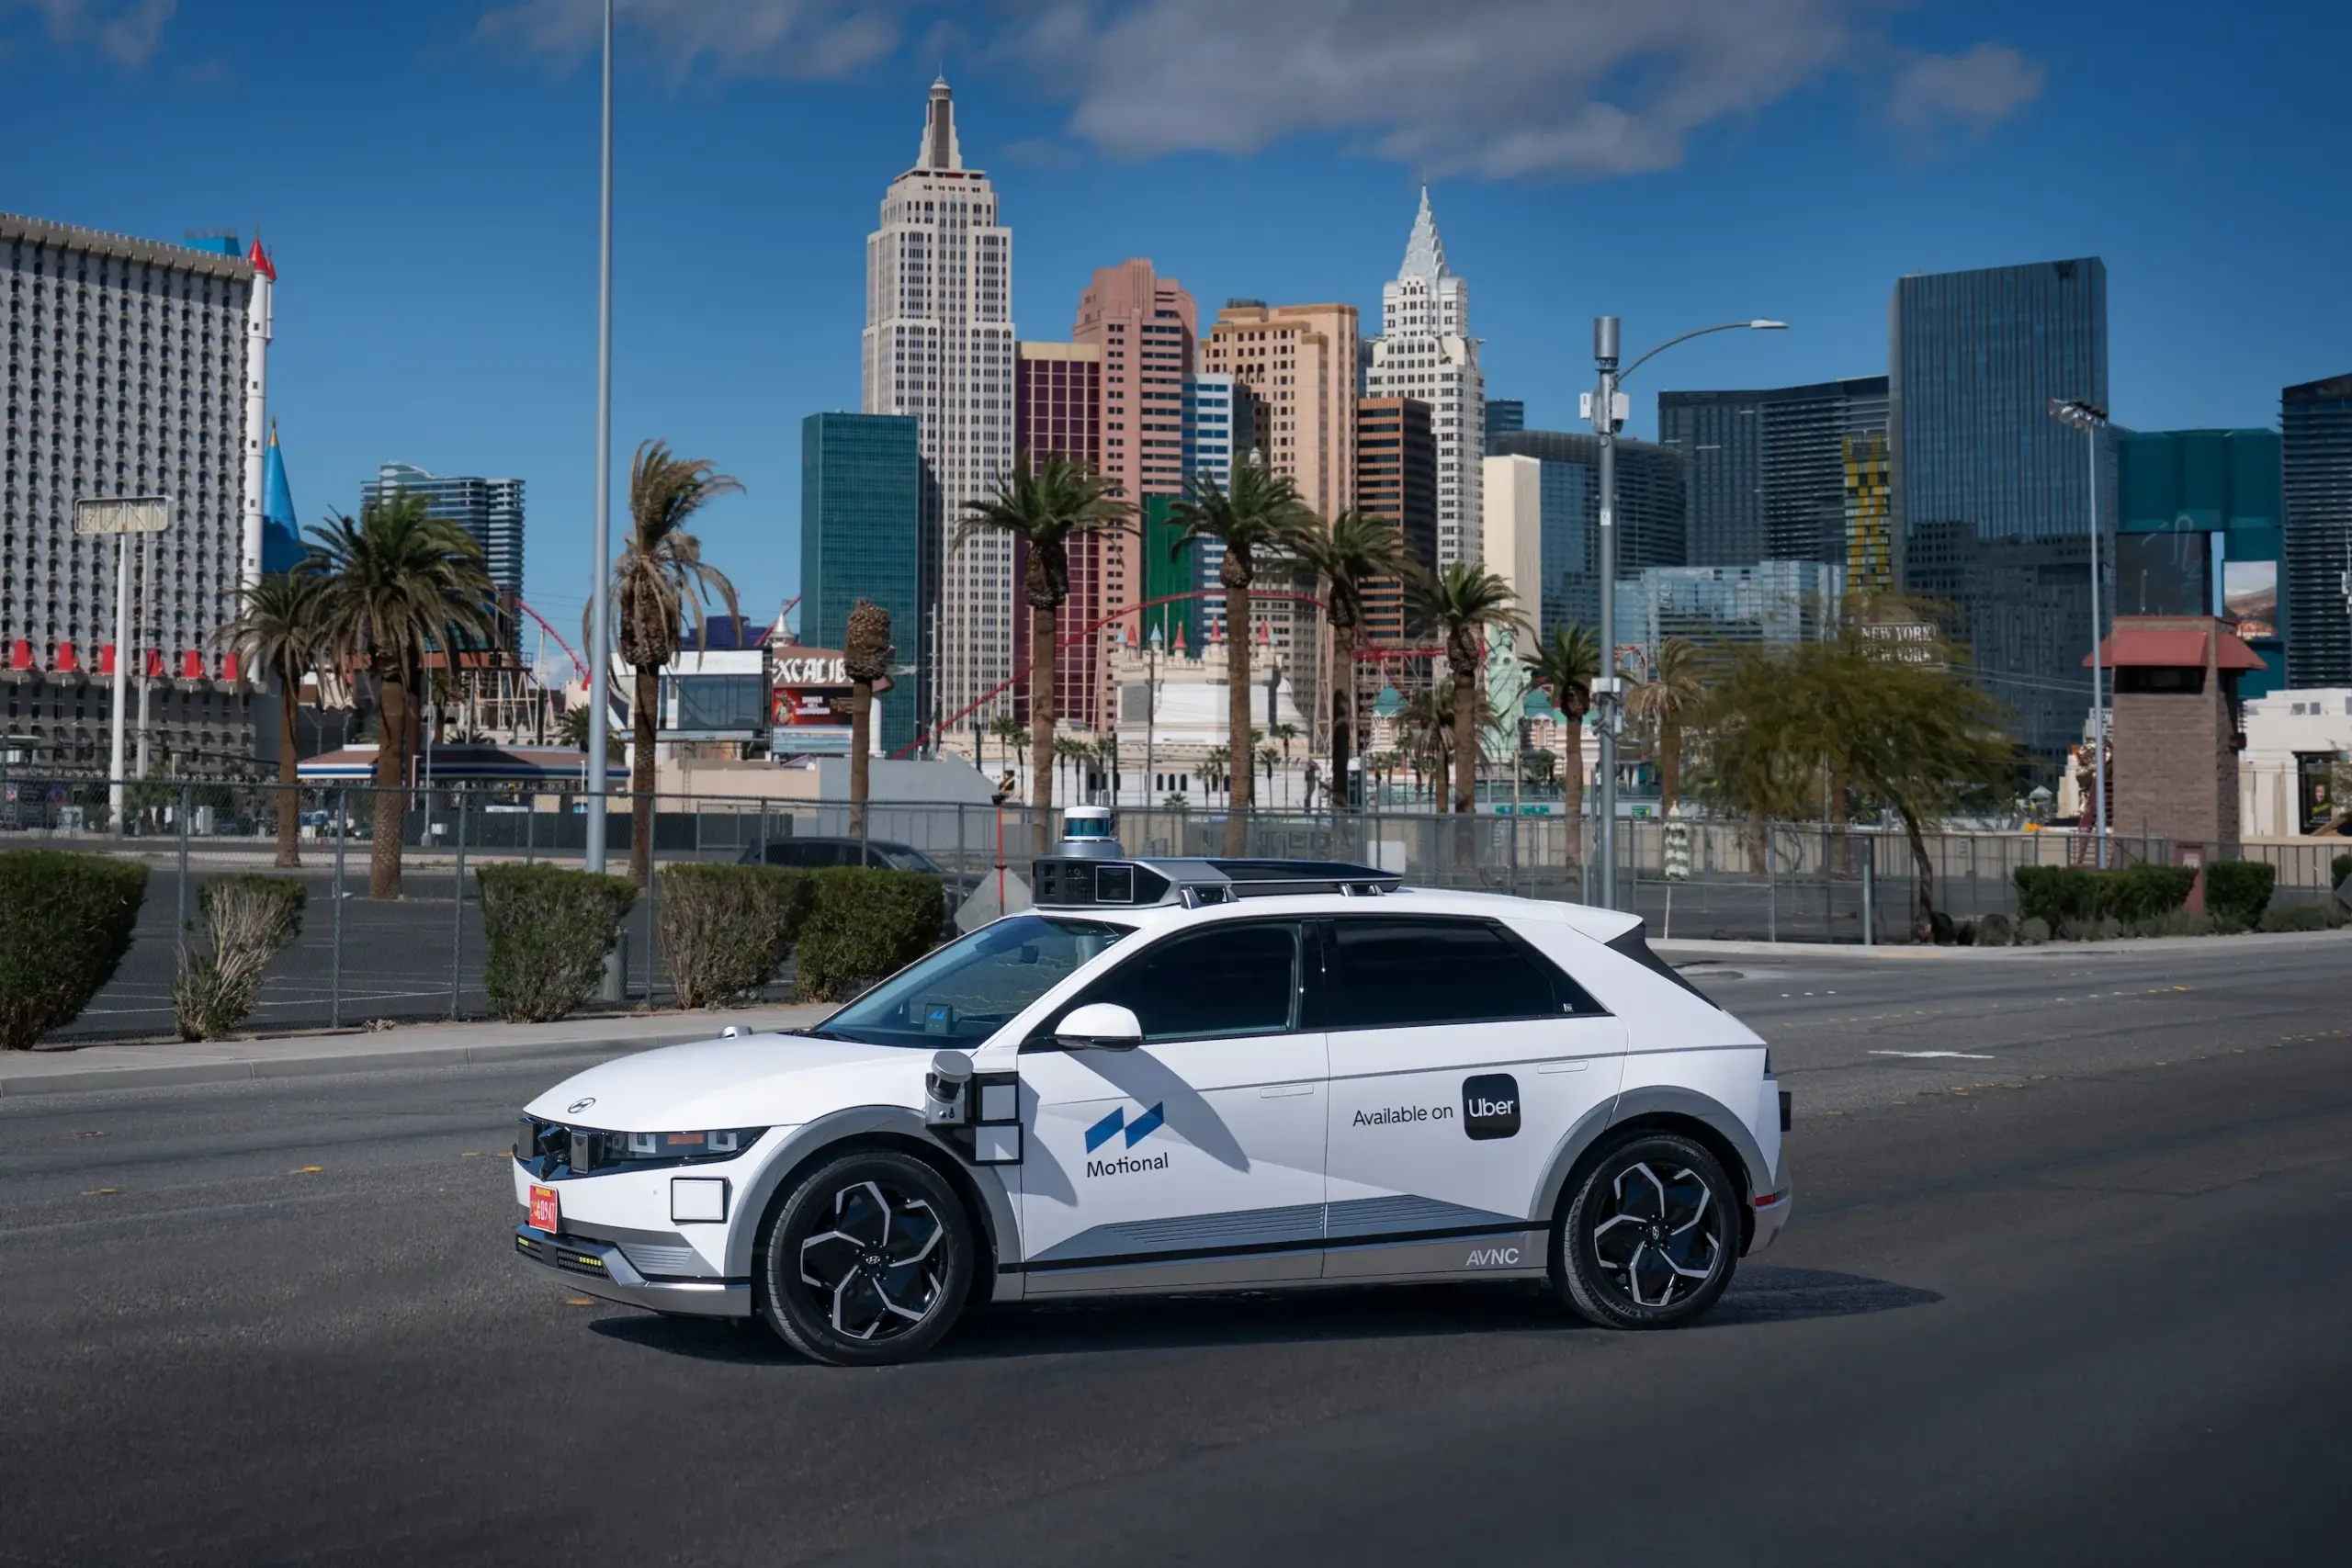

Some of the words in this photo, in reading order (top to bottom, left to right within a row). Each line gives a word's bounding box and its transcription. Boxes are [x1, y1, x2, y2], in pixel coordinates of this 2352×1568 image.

[1895, 626, 1933, 642] YORK
[1352, 1105, 1428, 1127] Available
[1431, 1106, 1453, 1120] on
[1468, 1098, 1514, 1118] Uber
[1087, 1151, 1169, 1178] Motional
[1465, 1247, 1520, 1266] AVNC
